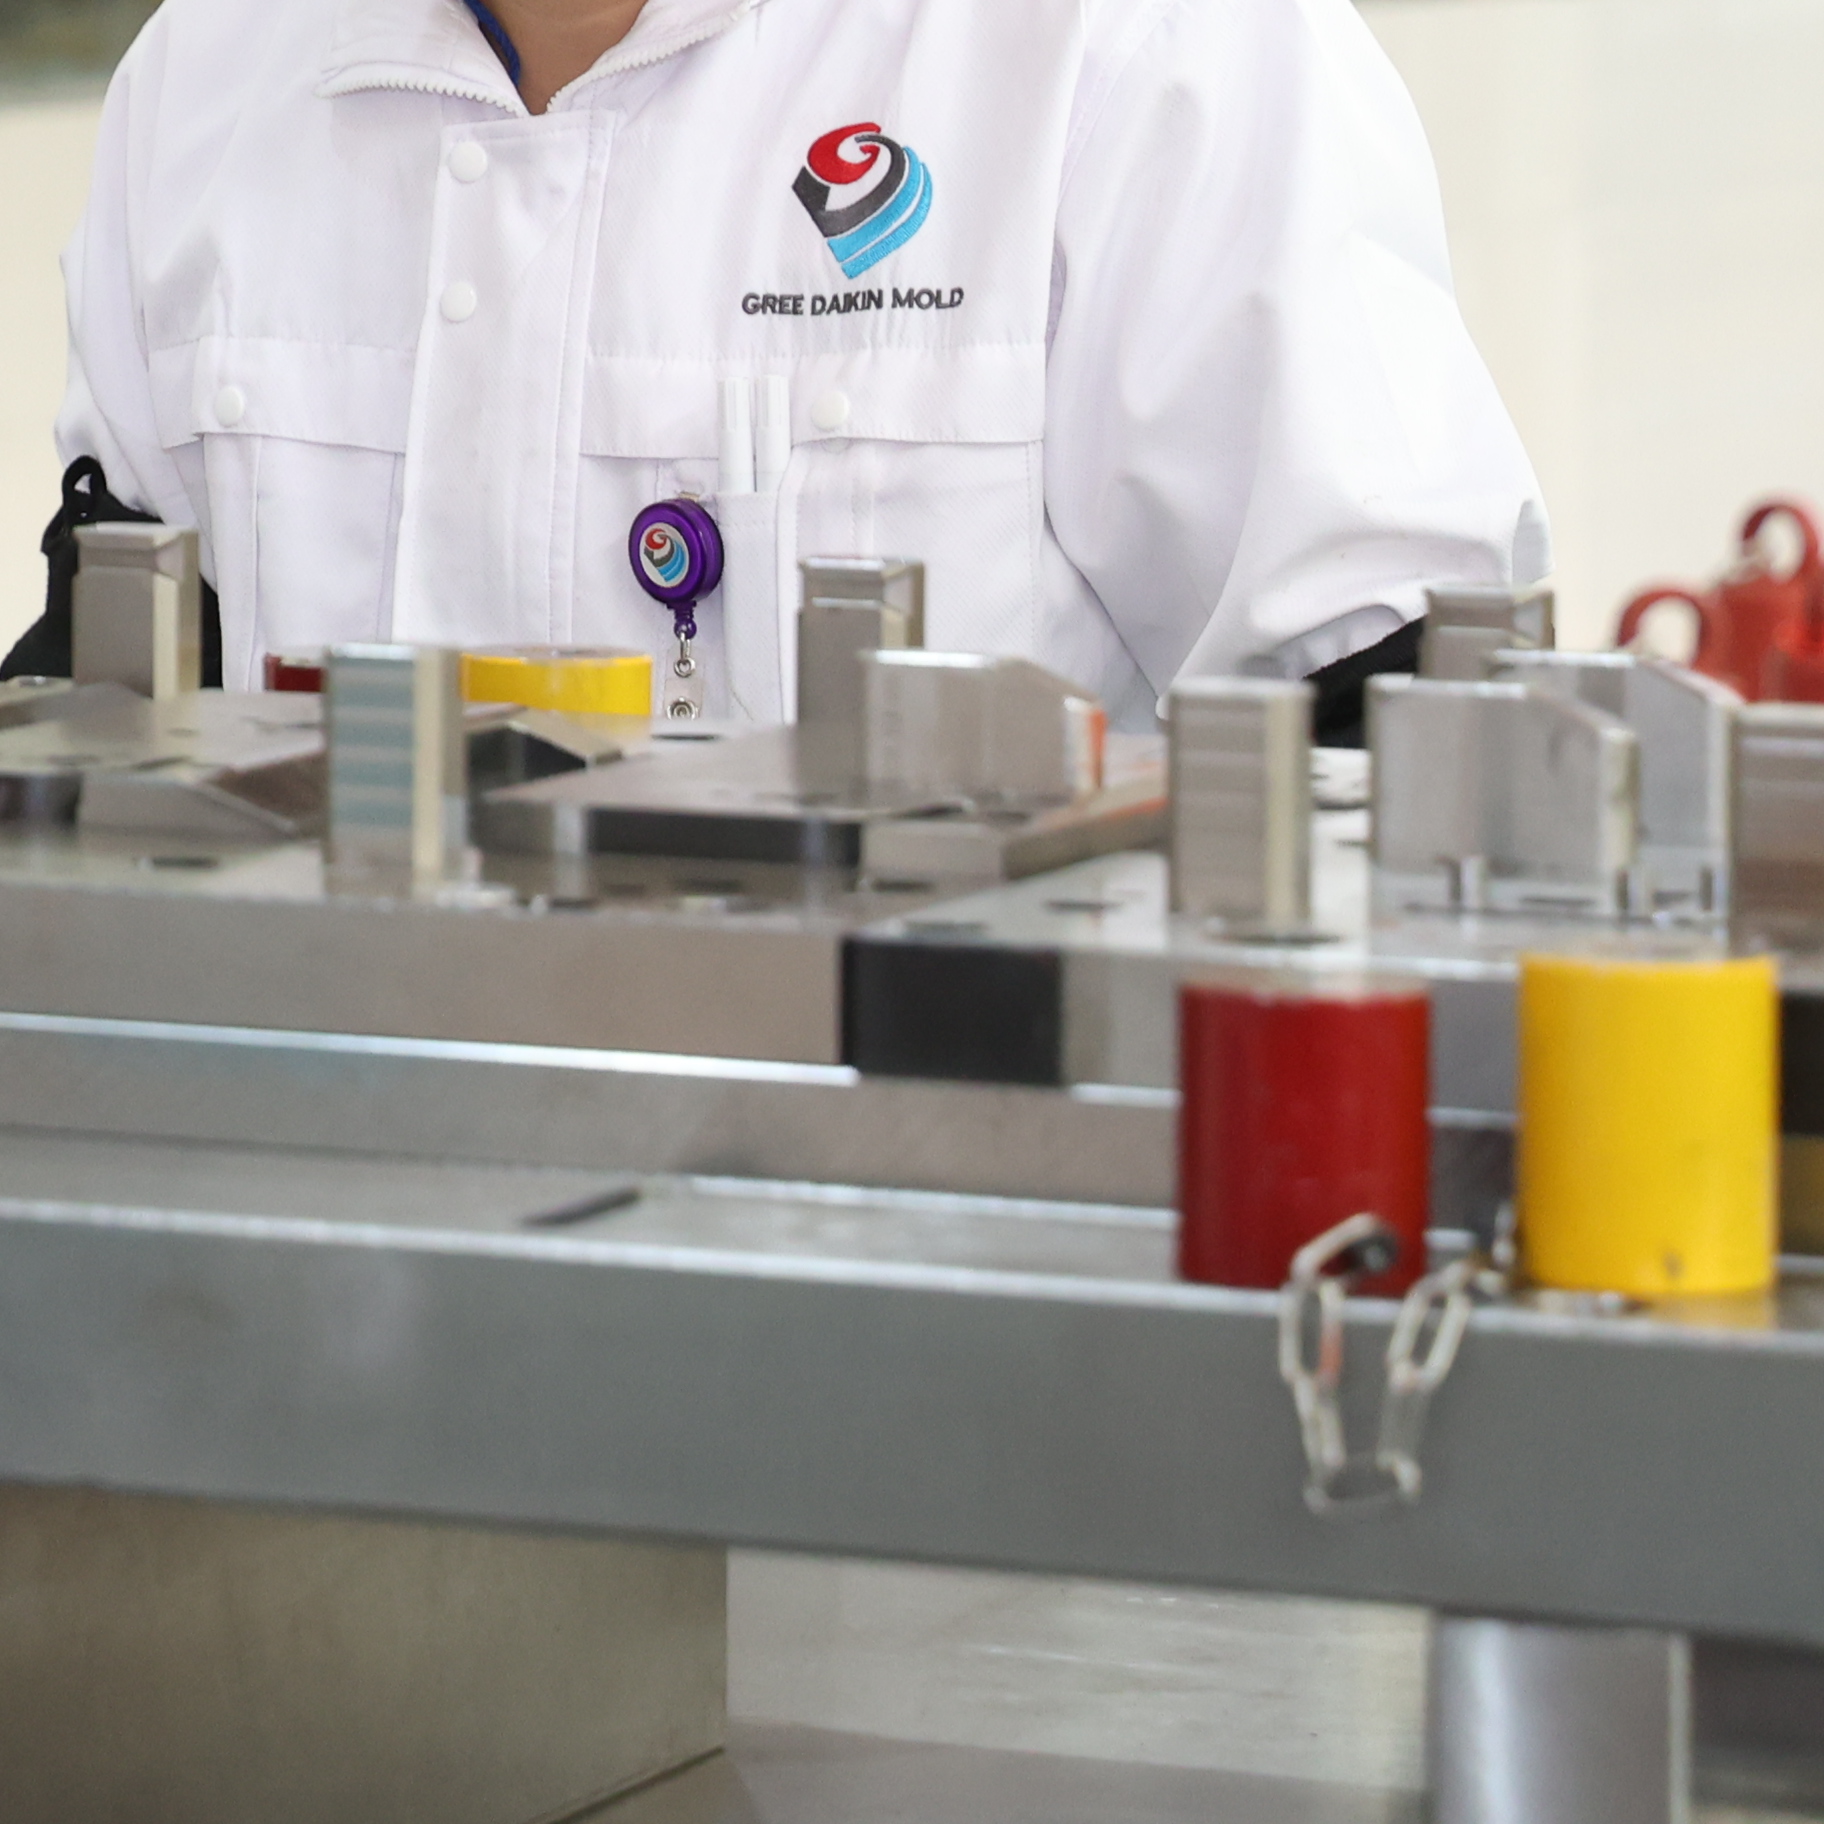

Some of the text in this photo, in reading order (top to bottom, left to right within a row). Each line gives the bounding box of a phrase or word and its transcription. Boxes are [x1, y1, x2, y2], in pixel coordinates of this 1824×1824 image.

[741, 287, 965, 316] GREE DAIKIN MOLD
